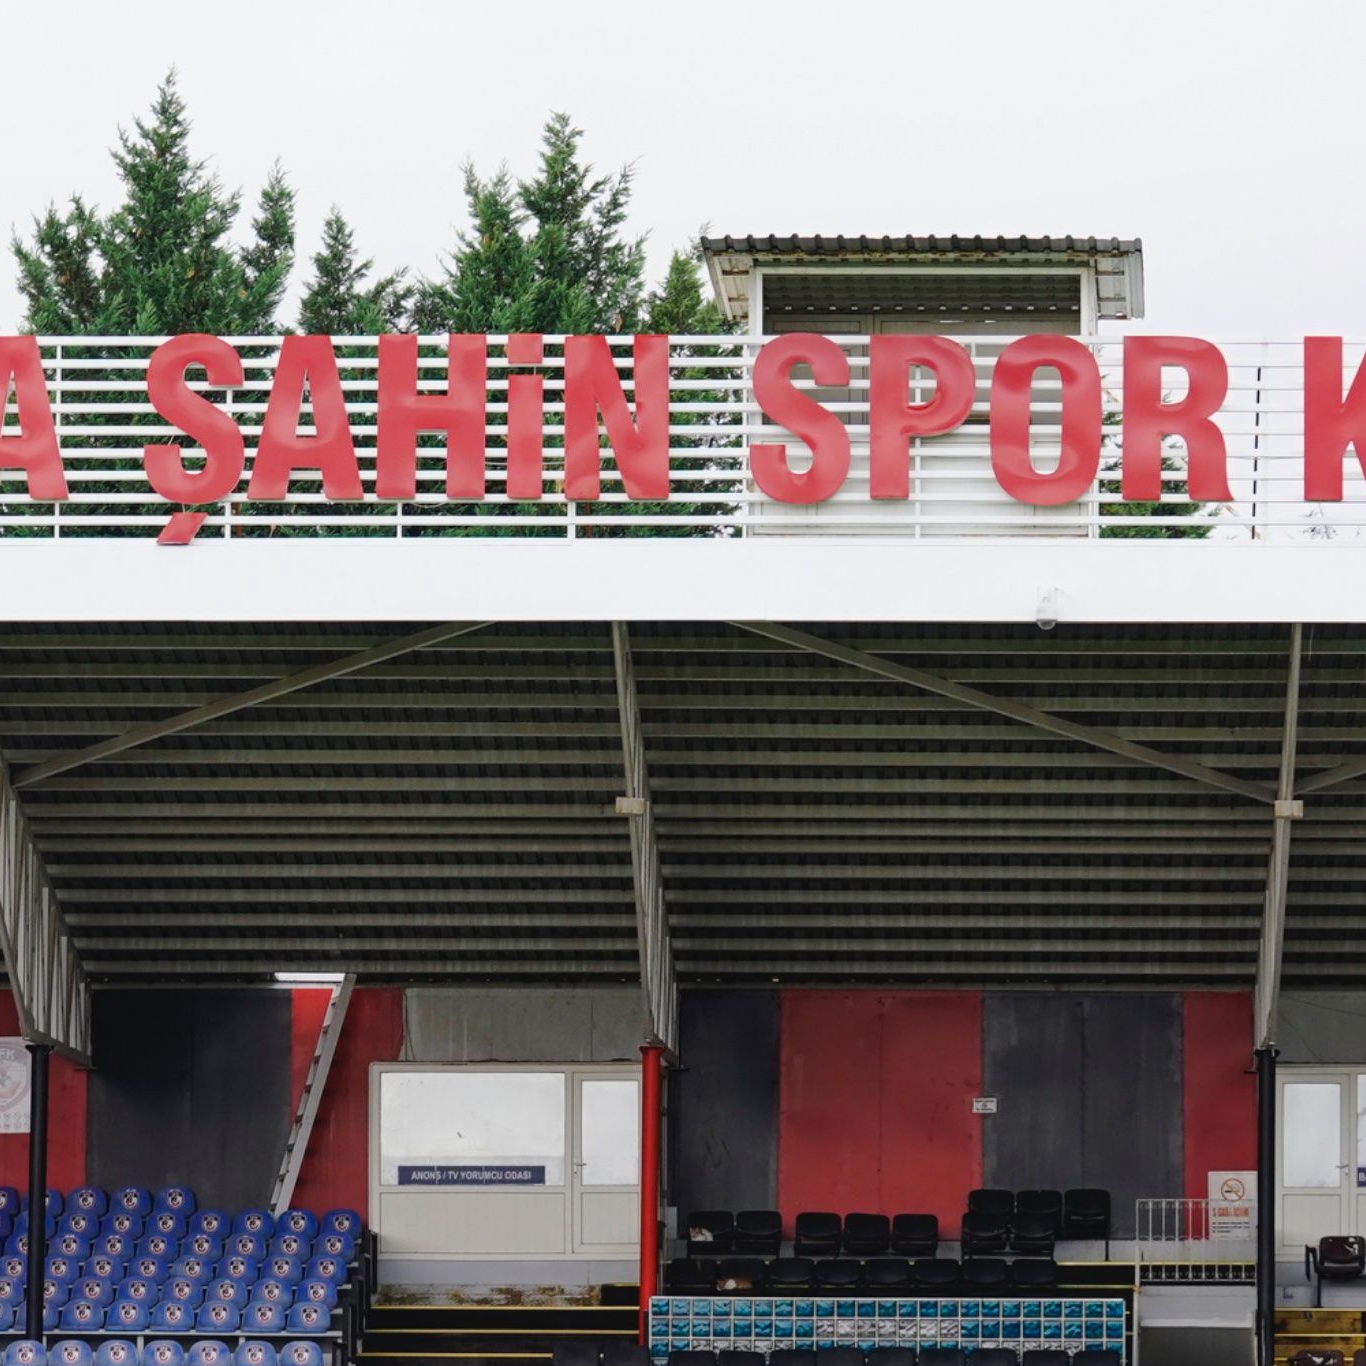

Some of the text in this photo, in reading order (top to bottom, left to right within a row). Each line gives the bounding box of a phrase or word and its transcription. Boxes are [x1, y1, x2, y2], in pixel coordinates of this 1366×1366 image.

[750, 333, 1233, 505] SPOR
[448, 1171, 459, 1180] TV
[460, 1171, 502, 1180] YORUMCU
[504, 1171, 531, 1180] ODASI
